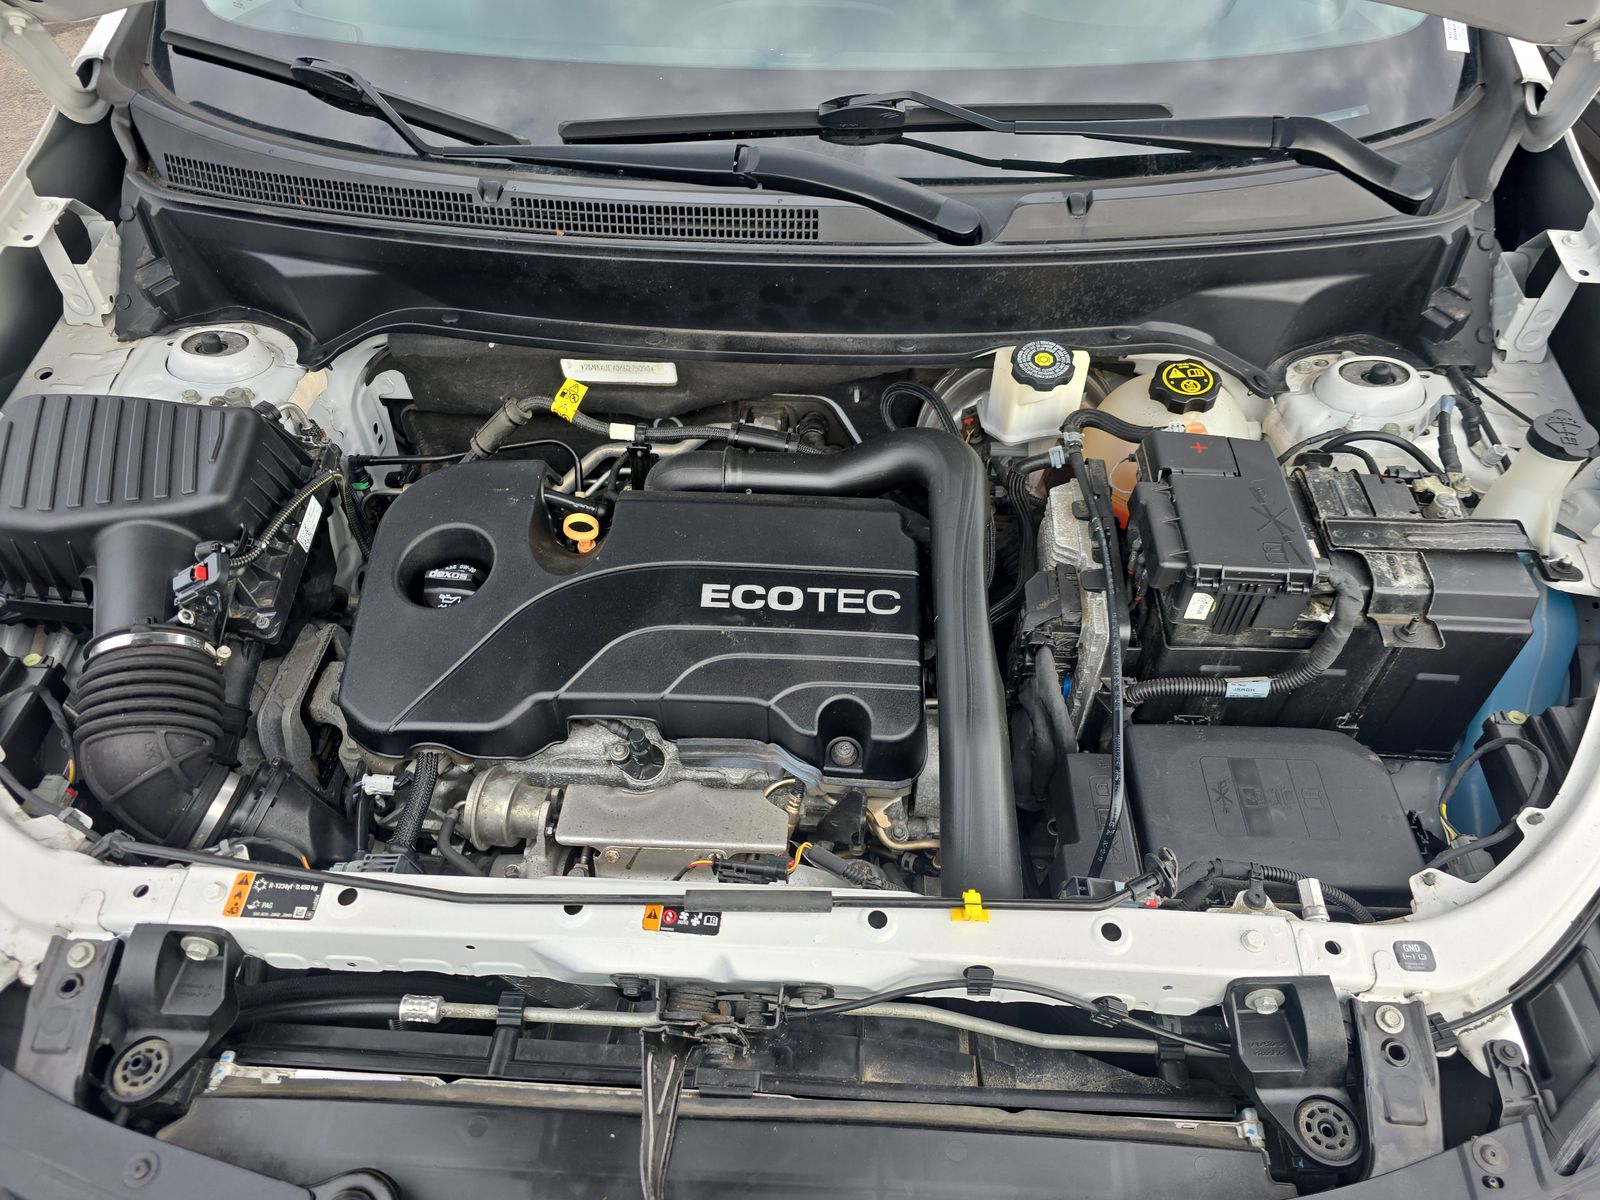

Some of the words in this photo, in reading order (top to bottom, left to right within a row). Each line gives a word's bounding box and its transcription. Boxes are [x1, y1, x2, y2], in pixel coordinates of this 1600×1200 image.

[429, 569, 468, 580] dexos
[700, 583, 901, 615] ECOTEC
[1402, 944, 1420, 952] GND
